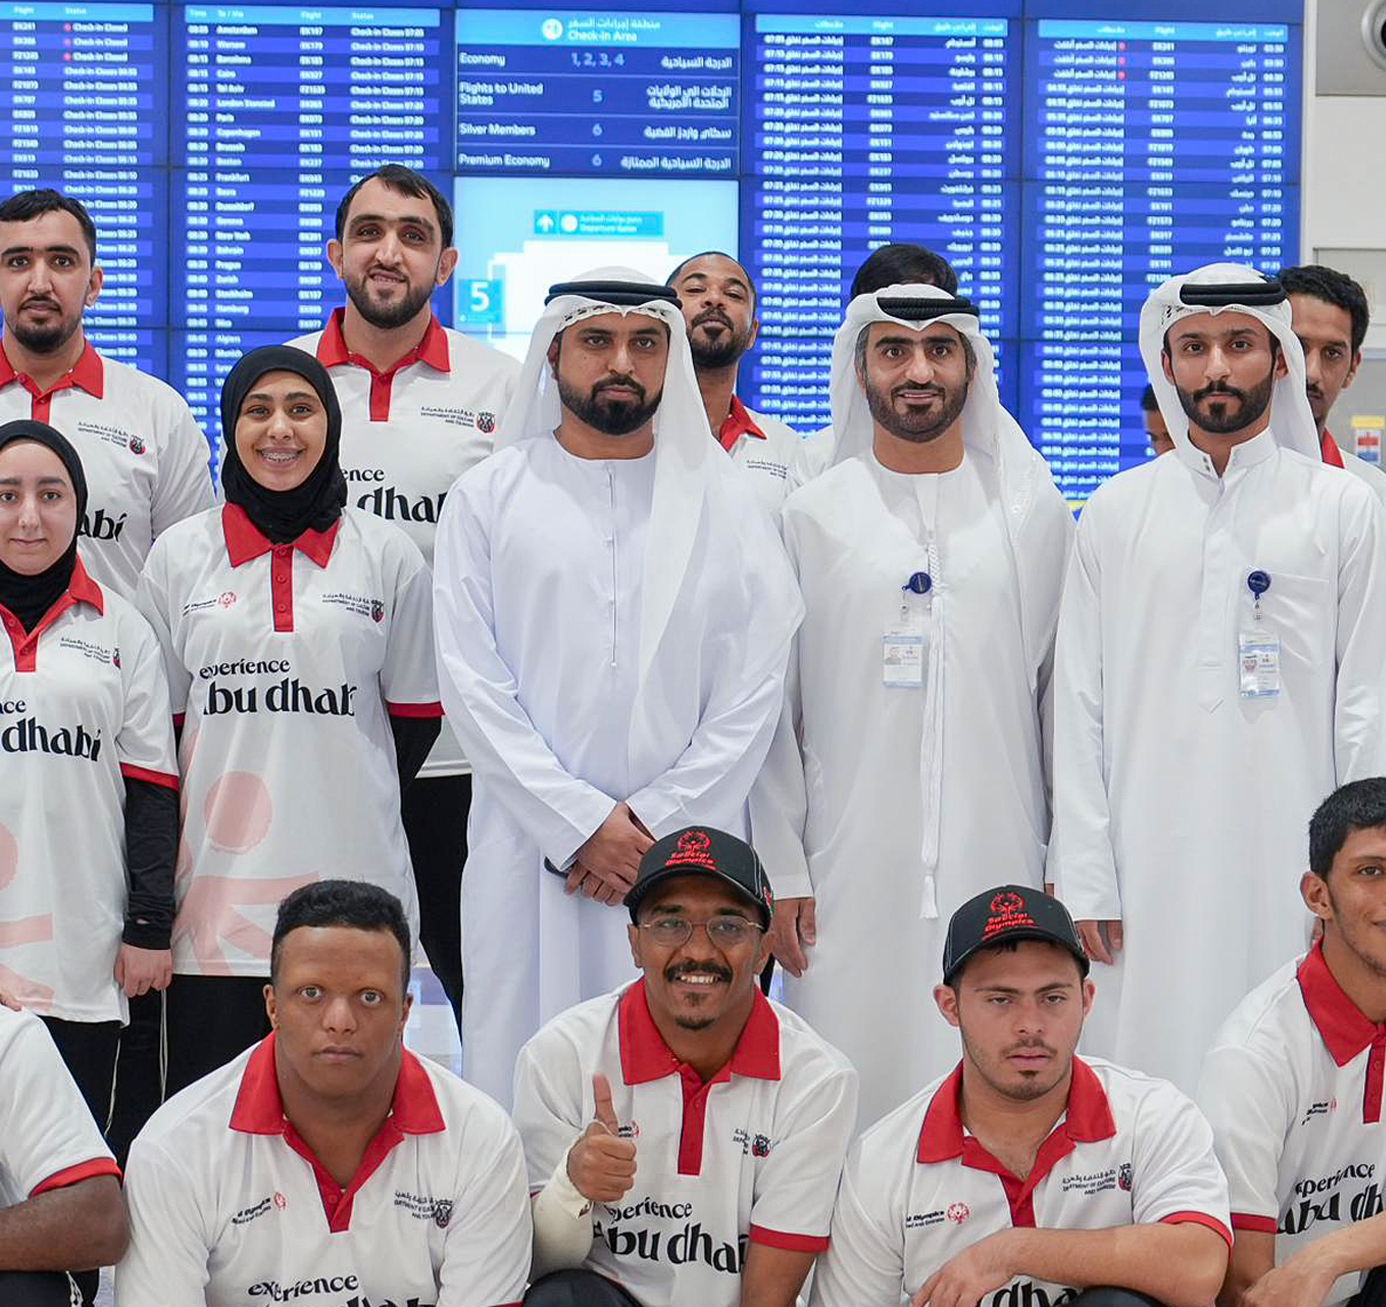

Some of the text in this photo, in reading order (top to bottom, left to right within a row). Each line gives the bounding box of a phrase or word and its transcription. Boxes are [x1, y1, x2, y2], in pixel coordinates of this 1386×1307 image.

[613, 32, 637, 42] Area
[459, 53, 505, 67] Economy
[459, 83, 543, 95] Flights to United
[459, 94, 493, 105] States
[593, 91, 602, 102] 5
[459, 124, 535, 136] Silver Members
[593, 124, 602, 135] 6
[459, 154, 550, 168] Premium Economy
[592, 155, 601, 166] 6
[471, 281, 490, 312] 5
[204, 681, 257, 716] bu
[1, 716, 101, 762] dhabi
